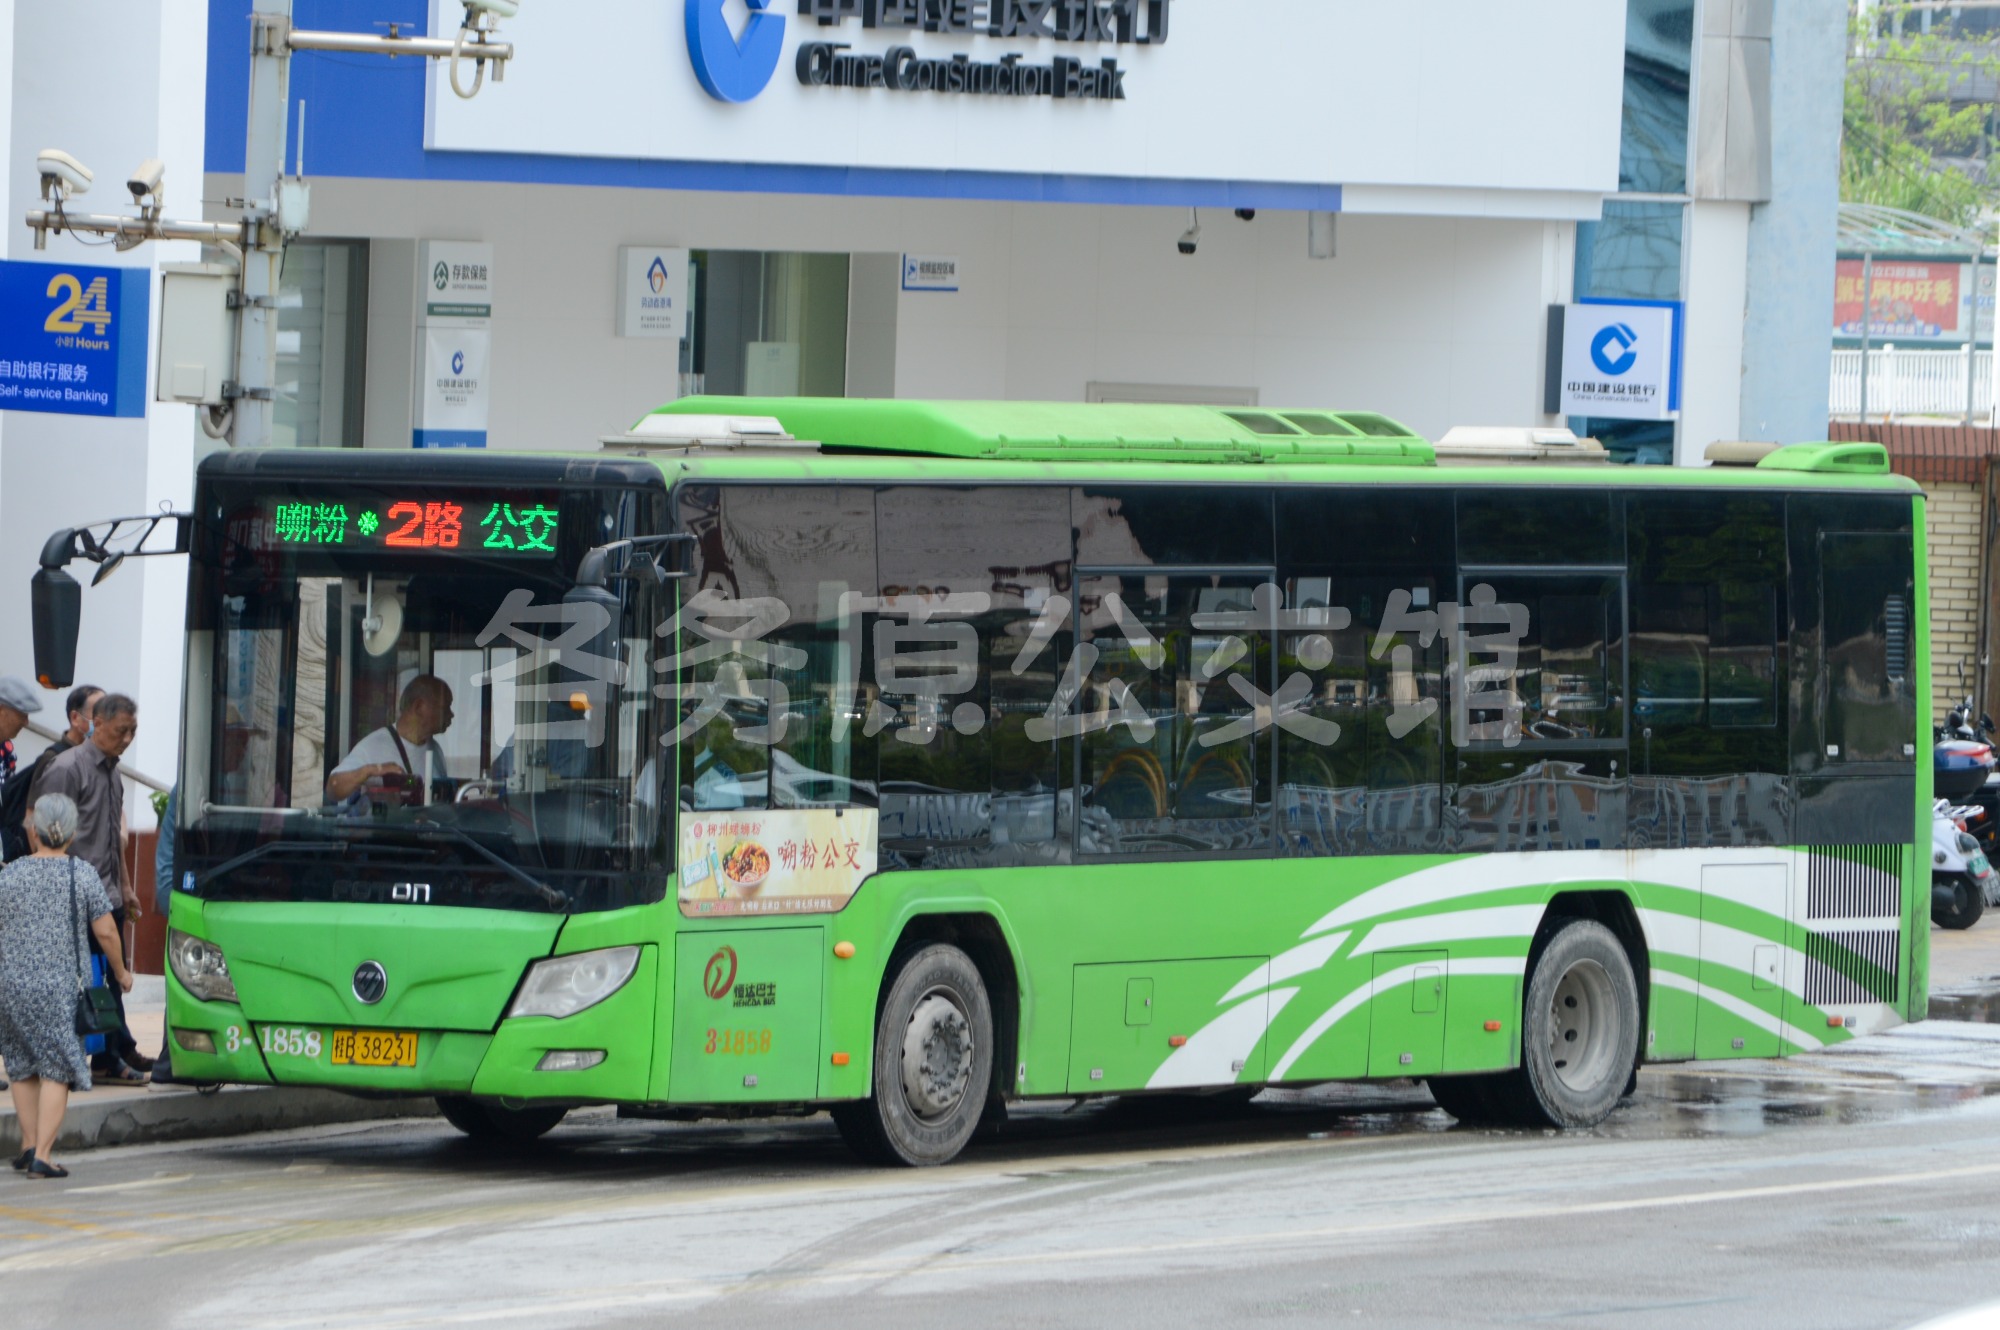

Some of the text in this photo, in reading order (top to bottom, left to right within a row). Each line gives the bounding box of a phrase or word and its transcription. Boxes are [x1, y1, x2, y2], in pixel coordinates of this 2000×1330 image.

[796, 42, 1126, 99] China Construction Bank
[452, 264, 487, 281] 存款保险
[44, 273, 111, 335] 24
[55, 335, 109, 350] 小时 Hours
[0, 359, 88, 382] 自助银行服务
[436, 378, 478, 389] 中国建设银行
[1567, 381, 1656, 396] 中国建设银行
[64, 388, 108, 405] Banking
[386, 502, 463, 547] 2路
[480, 503, 558, 551] 公交
[734, 982, 776, 998] 恒达巴士
